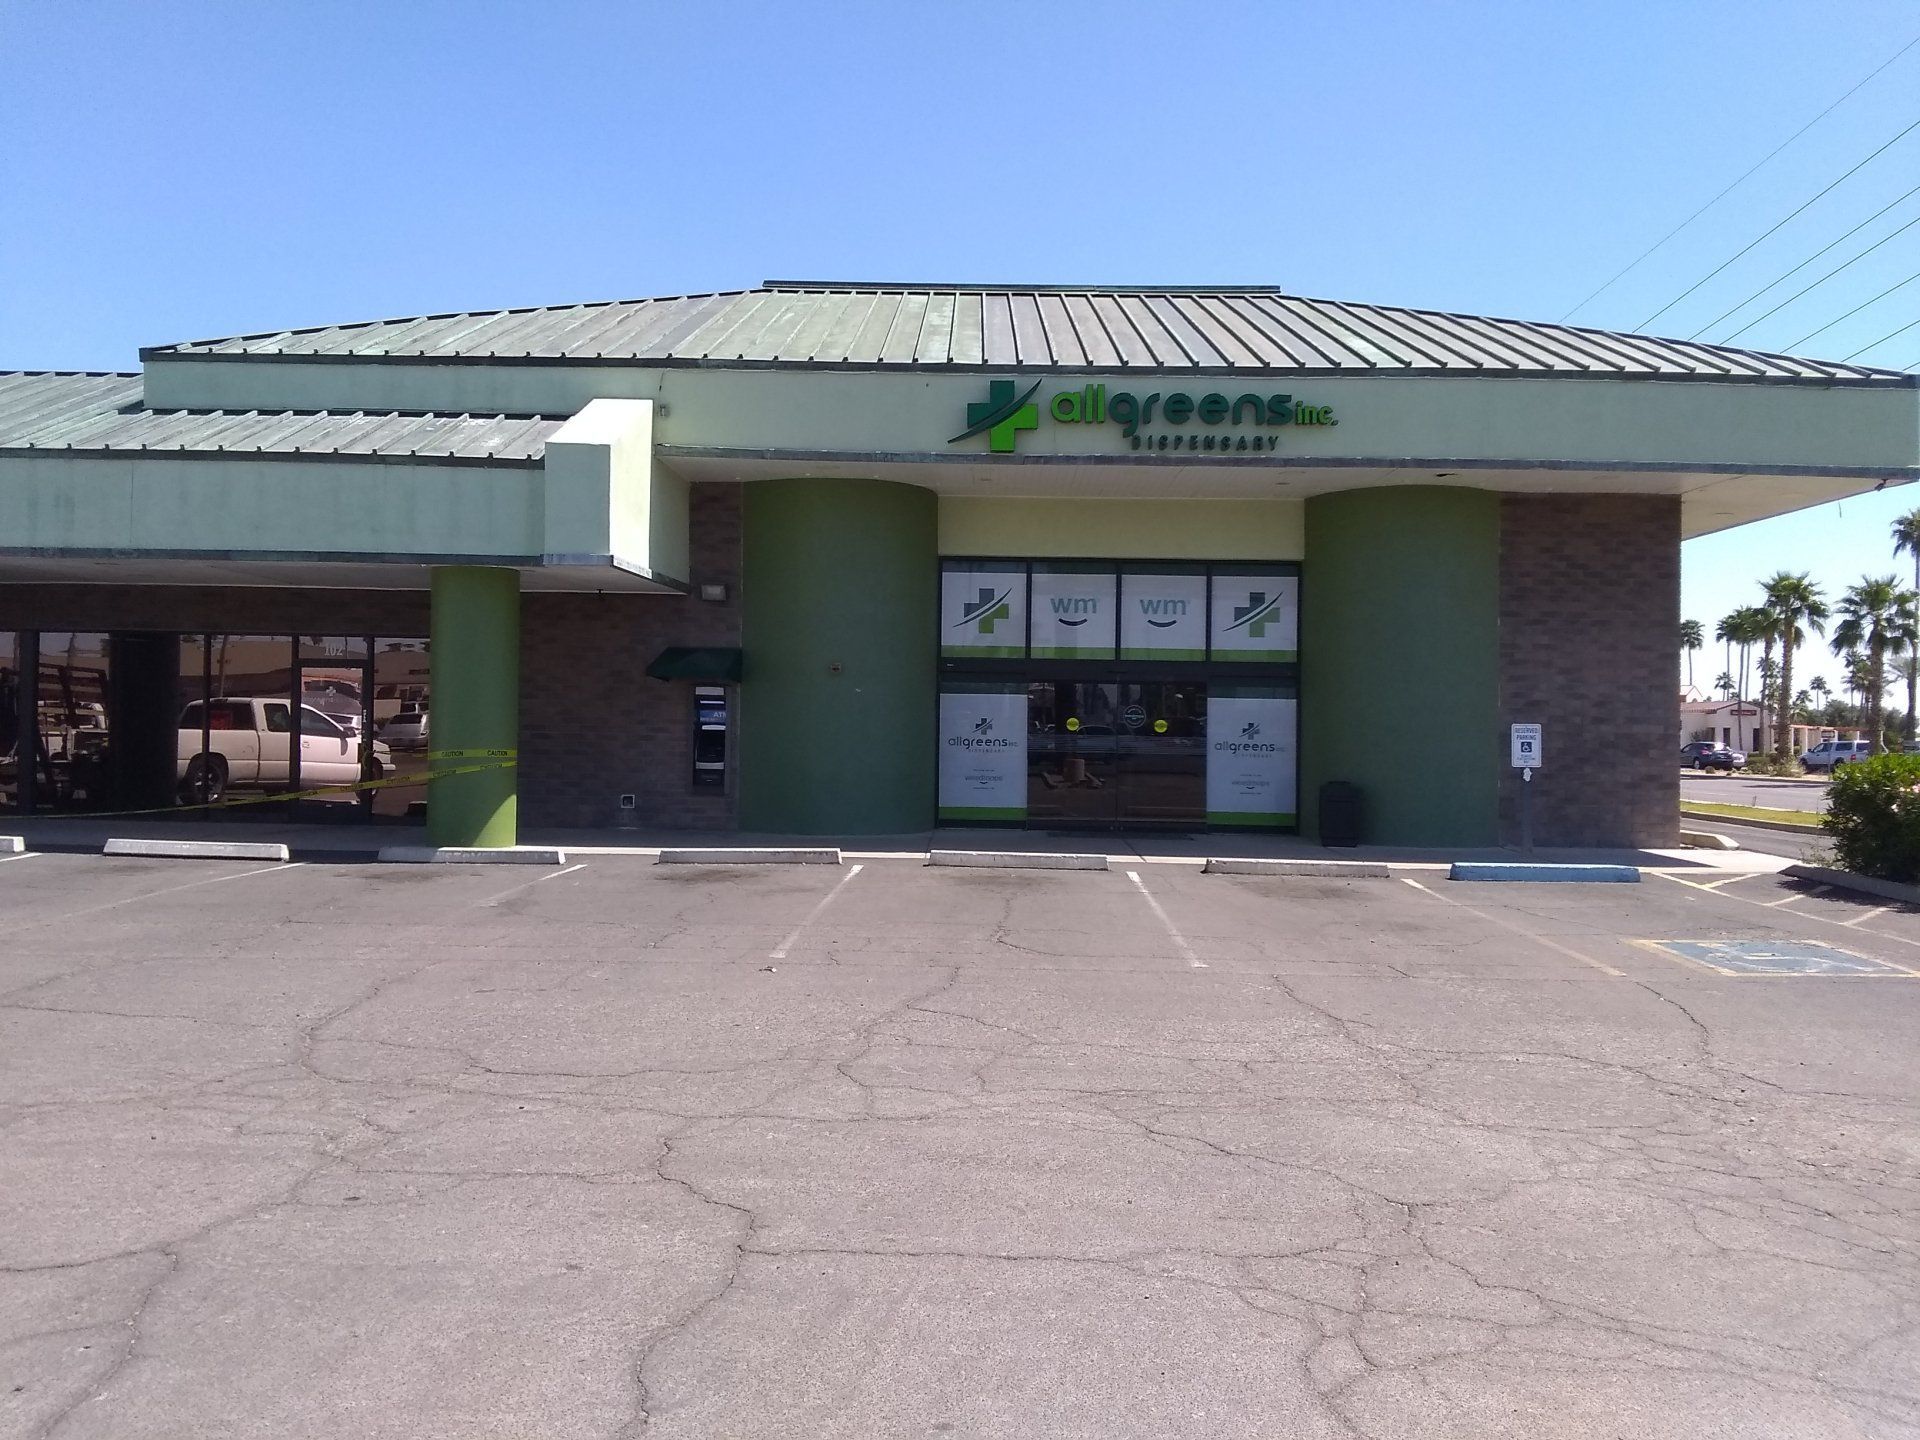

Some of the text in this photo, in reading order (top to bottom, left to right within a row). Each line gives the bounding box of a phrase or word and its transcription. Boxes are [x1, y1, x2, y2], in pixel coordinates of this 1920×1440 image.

[1050, 383, 1339, 438] allgreens inc.
[1131, 434, 1280, 452] DISPENSARY
[1050, 597, 1097, 614] wm
[1139, 599, 1187, 615] wm
[324, 644, 343, 656] 102
[948, 736, 1008, 750] allgreens
[1214, 741, 1275, 754] allgreens
